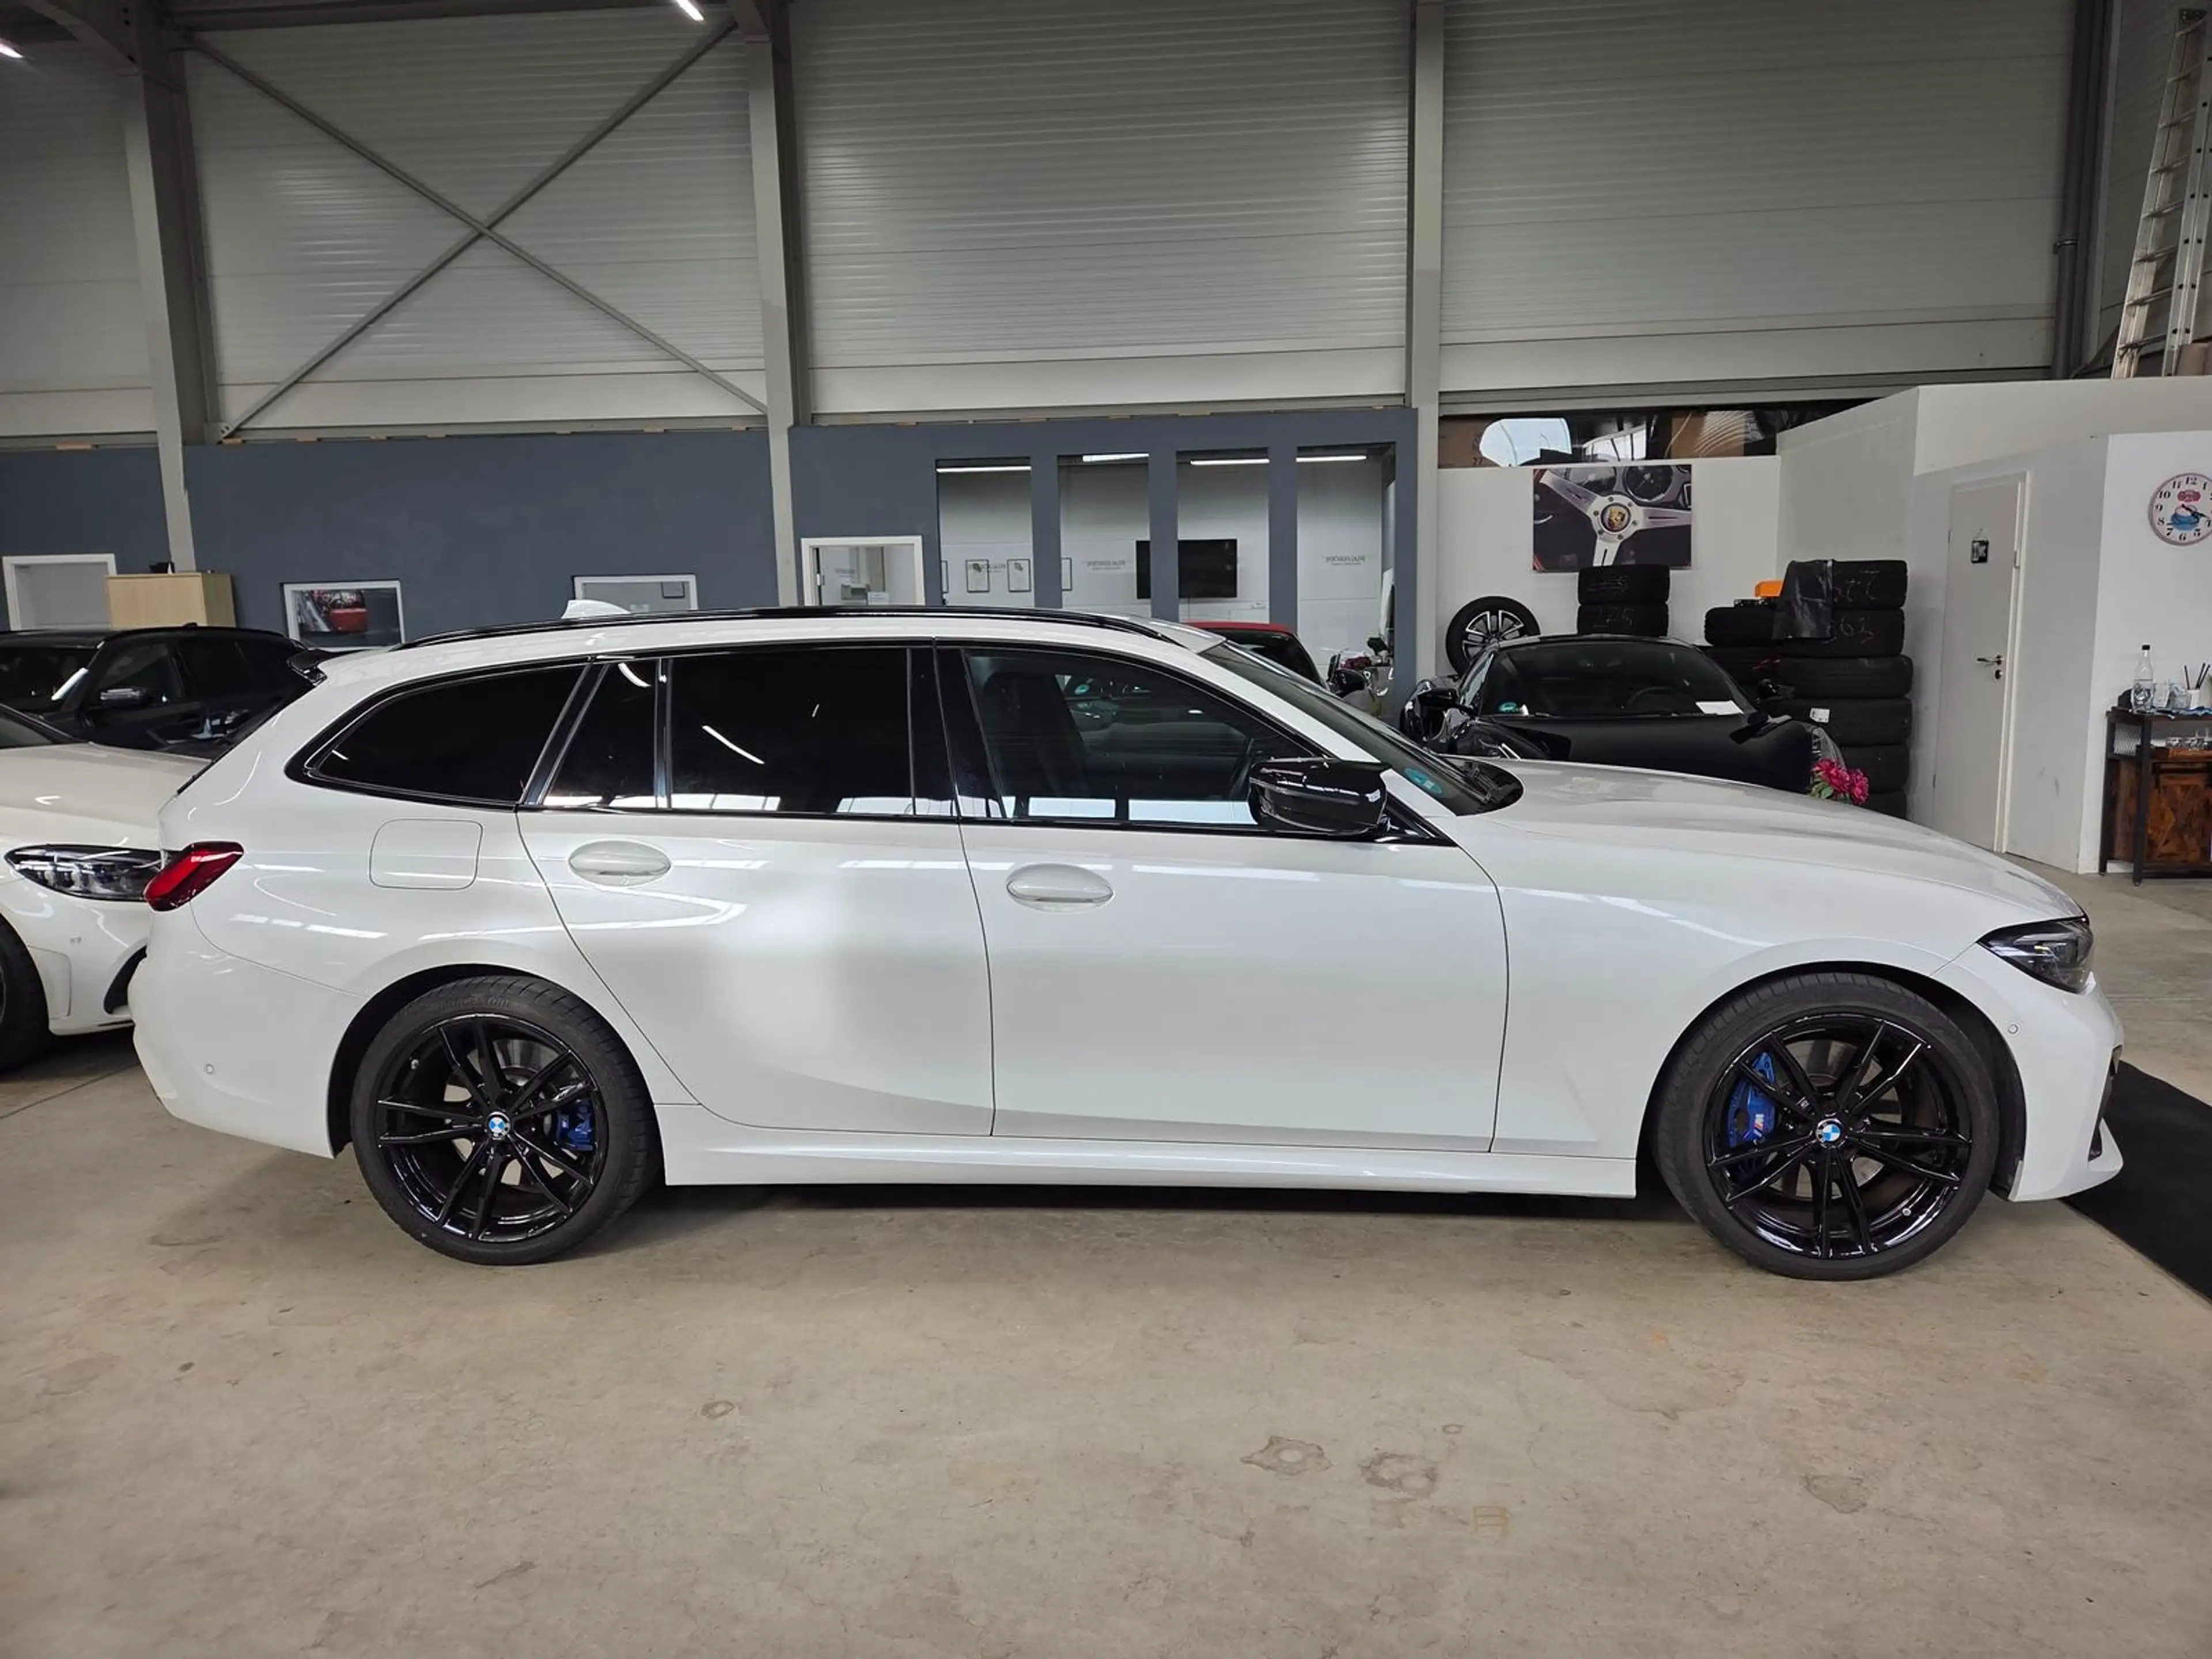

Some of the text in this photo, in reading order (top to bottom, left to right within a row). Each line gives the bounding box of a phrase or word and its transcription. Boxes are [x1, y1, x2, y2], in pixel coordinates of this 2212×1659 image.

[2186, 476, 2198, 485] 12
[2203, 482, 2207, 490] 1
[2159, 490, 2171, 499] 10
[2157, 517, 2165, 525] 8
[2166, 528, 2173, 536] 7
[2179, 532, 2187, 540] 6
[2193, 528, 2200, 536] 5
